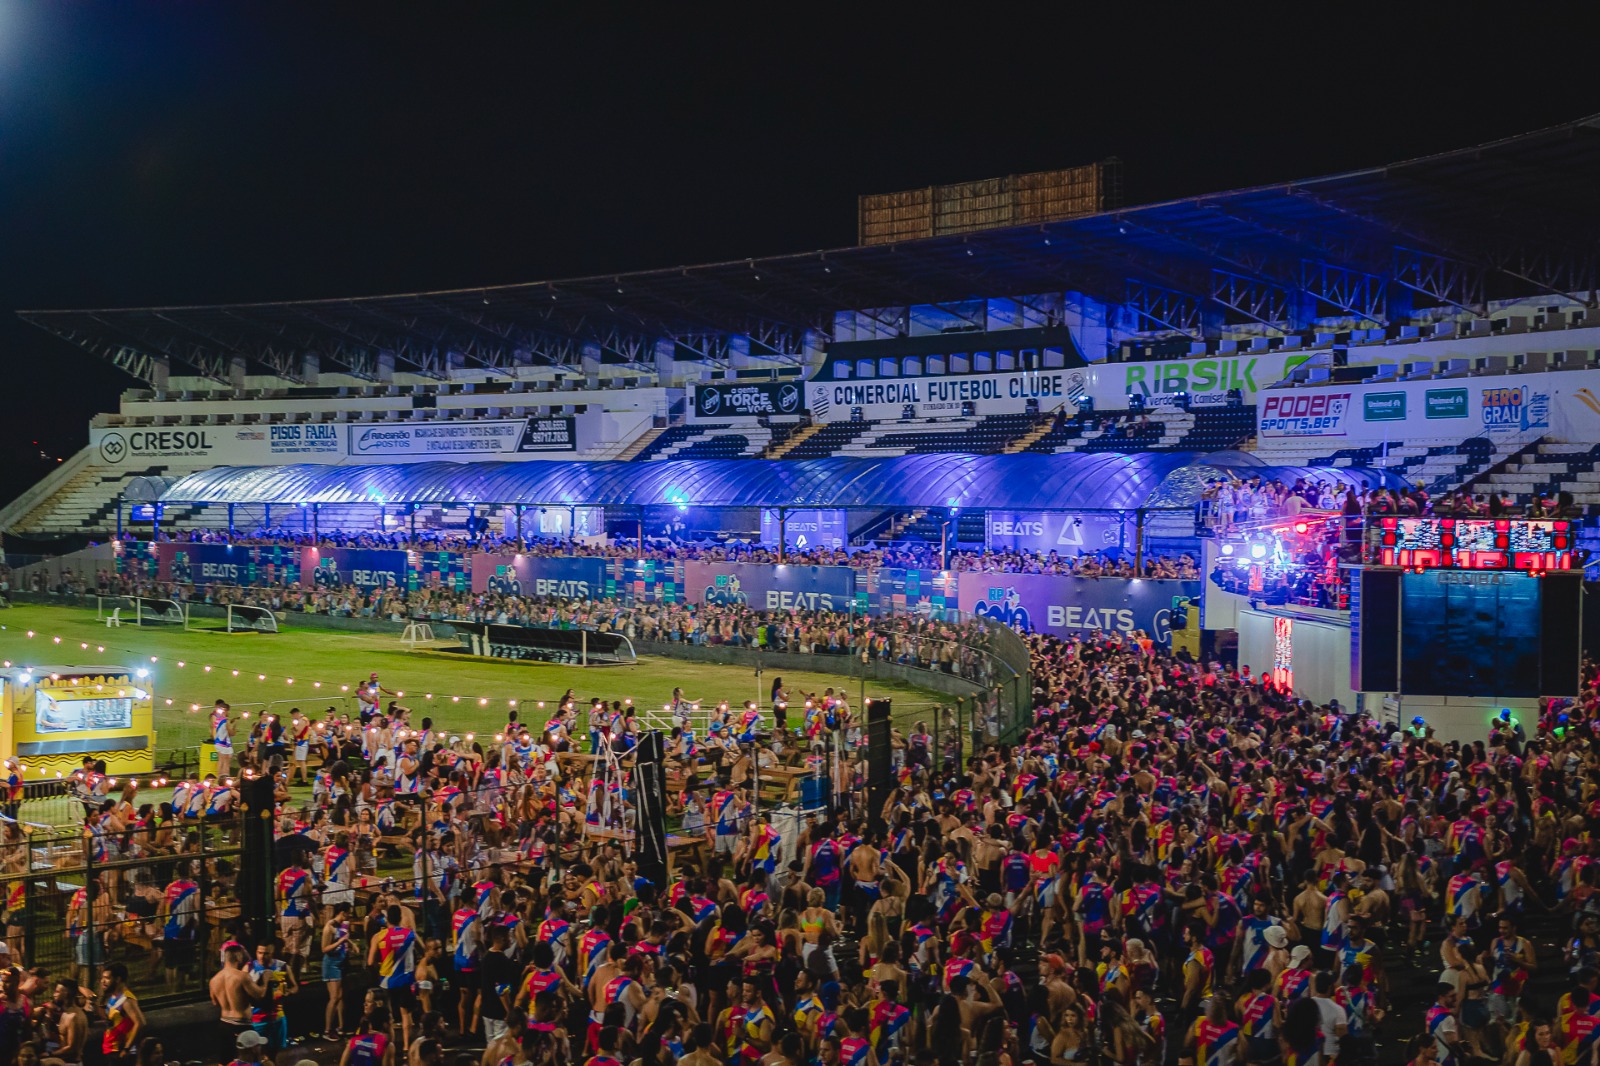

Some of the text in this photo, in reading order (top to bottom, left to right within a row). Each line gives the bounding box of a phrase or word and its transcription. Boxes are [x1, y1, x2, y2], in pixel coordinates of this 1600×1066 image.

[1125, 358, 1258, 397] RIBSILK
[834, 375, 1063, 405] COMERCIAL FUTEBOL CLUBE
[1482, 388, 1522, 406] ZERO
[723, 392, 769, 407] TORCE
[1483, 405, 1521, 424] GRAU
[130, 431, 213, 450] CRESOL
[270, 426, 301, 440] PISOS
[305, 425, 337, 439] FARIA
[787, 522, 818, 532] BEATS
[992, 521, 1043, 536] BEATS
[202, 563, 239, 578] BEATS
[353, 569, 396, 586] BEATS
[536, 578, 589, 598] BEATS
[766, 590, 833, 611] BEATS
[1047, 605, 1135, 631] BEATS
